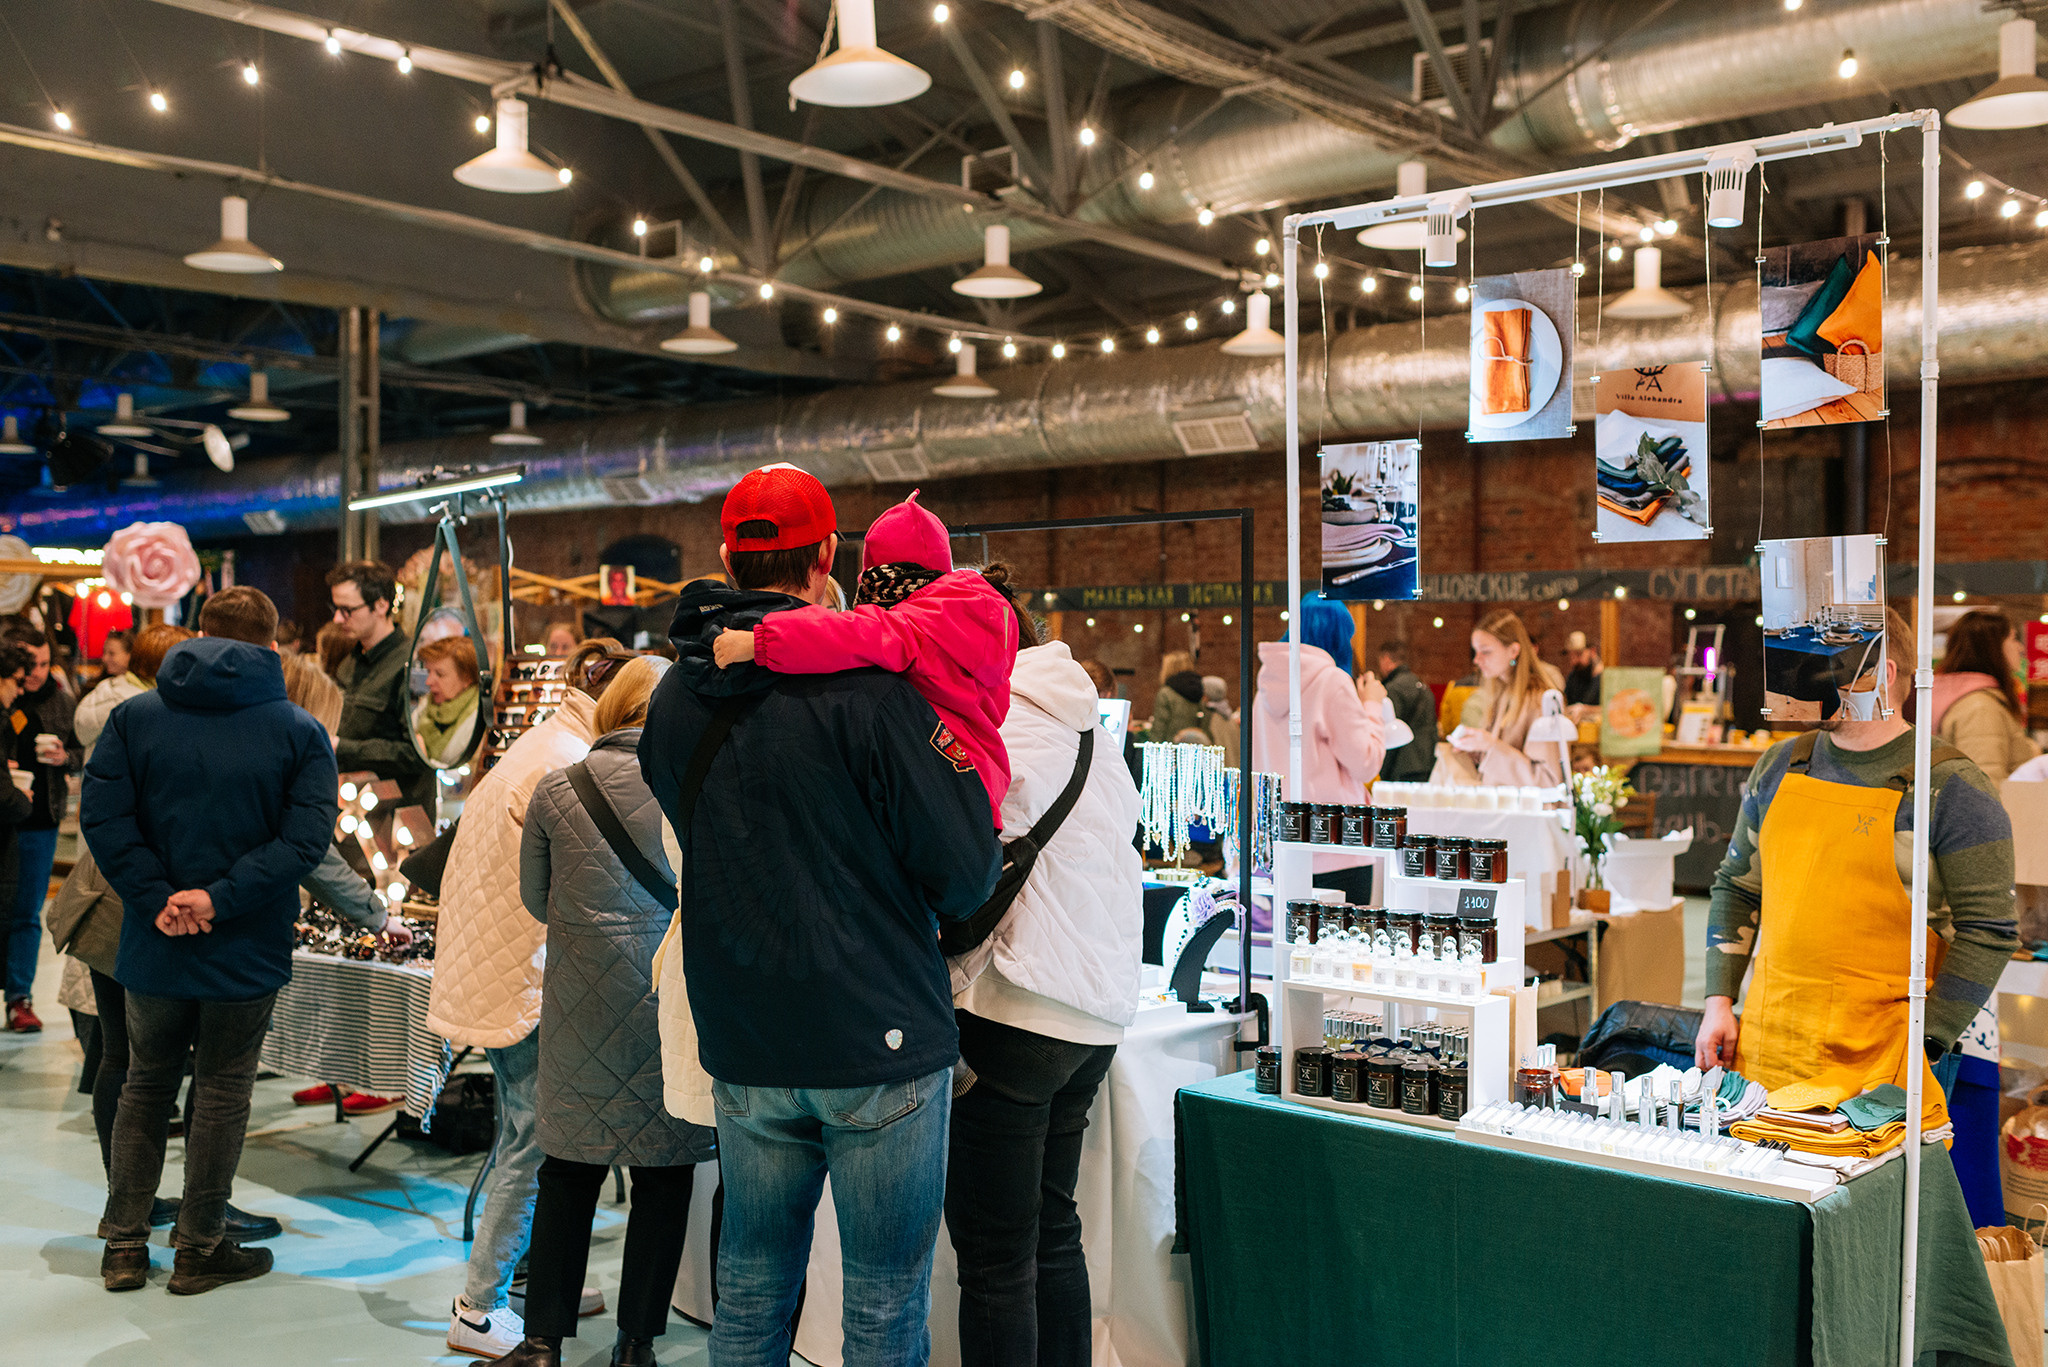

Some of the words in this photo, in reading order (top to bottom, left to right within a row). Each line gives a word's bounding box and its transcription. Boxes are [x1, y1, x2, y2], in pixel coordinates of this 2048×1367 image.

[1615, 393, 1635, 401] Villa
[1421, 572, 1529, 602] НЦОВСКИЕ
[1648, 566, 1761, 601] СУПСТА
[1464, 895, 1490, 909] 1100
